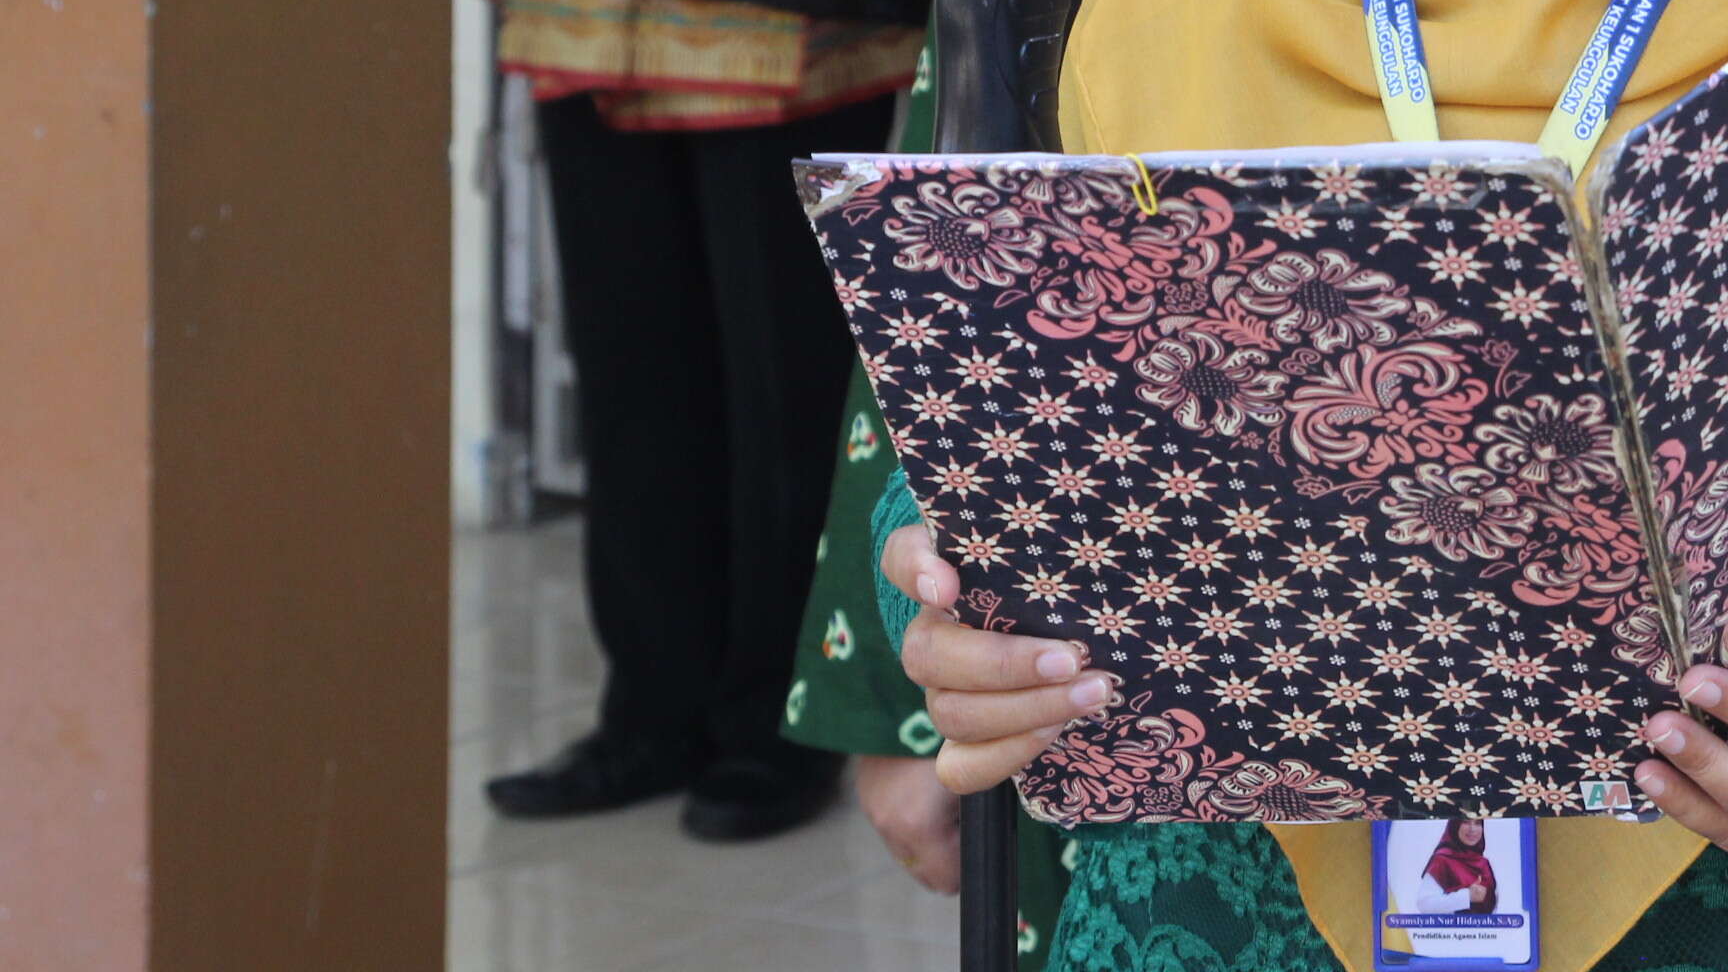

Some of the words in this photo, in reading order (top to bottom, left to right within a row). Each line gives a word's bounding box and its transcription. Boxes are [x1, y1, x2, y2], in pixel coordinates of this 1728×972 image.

[1394, 2, 1425, 102] SUKOHARJO
[1560, 4, 1626, 114] KEUNGGULAN
[1574, 33, 1635, 140] SUKOHARJO
[1389, 916, 1436, 928] Syamsiyah
[1437, 916, 1454, 925] Nur
[1456, 916, 1495, 928] Hidayah,
[1412, 932, 1451, 940] Pendidikan
[1453, 932, 1477, 941] Agama
[1478, 932, 1497, 940] Islam
